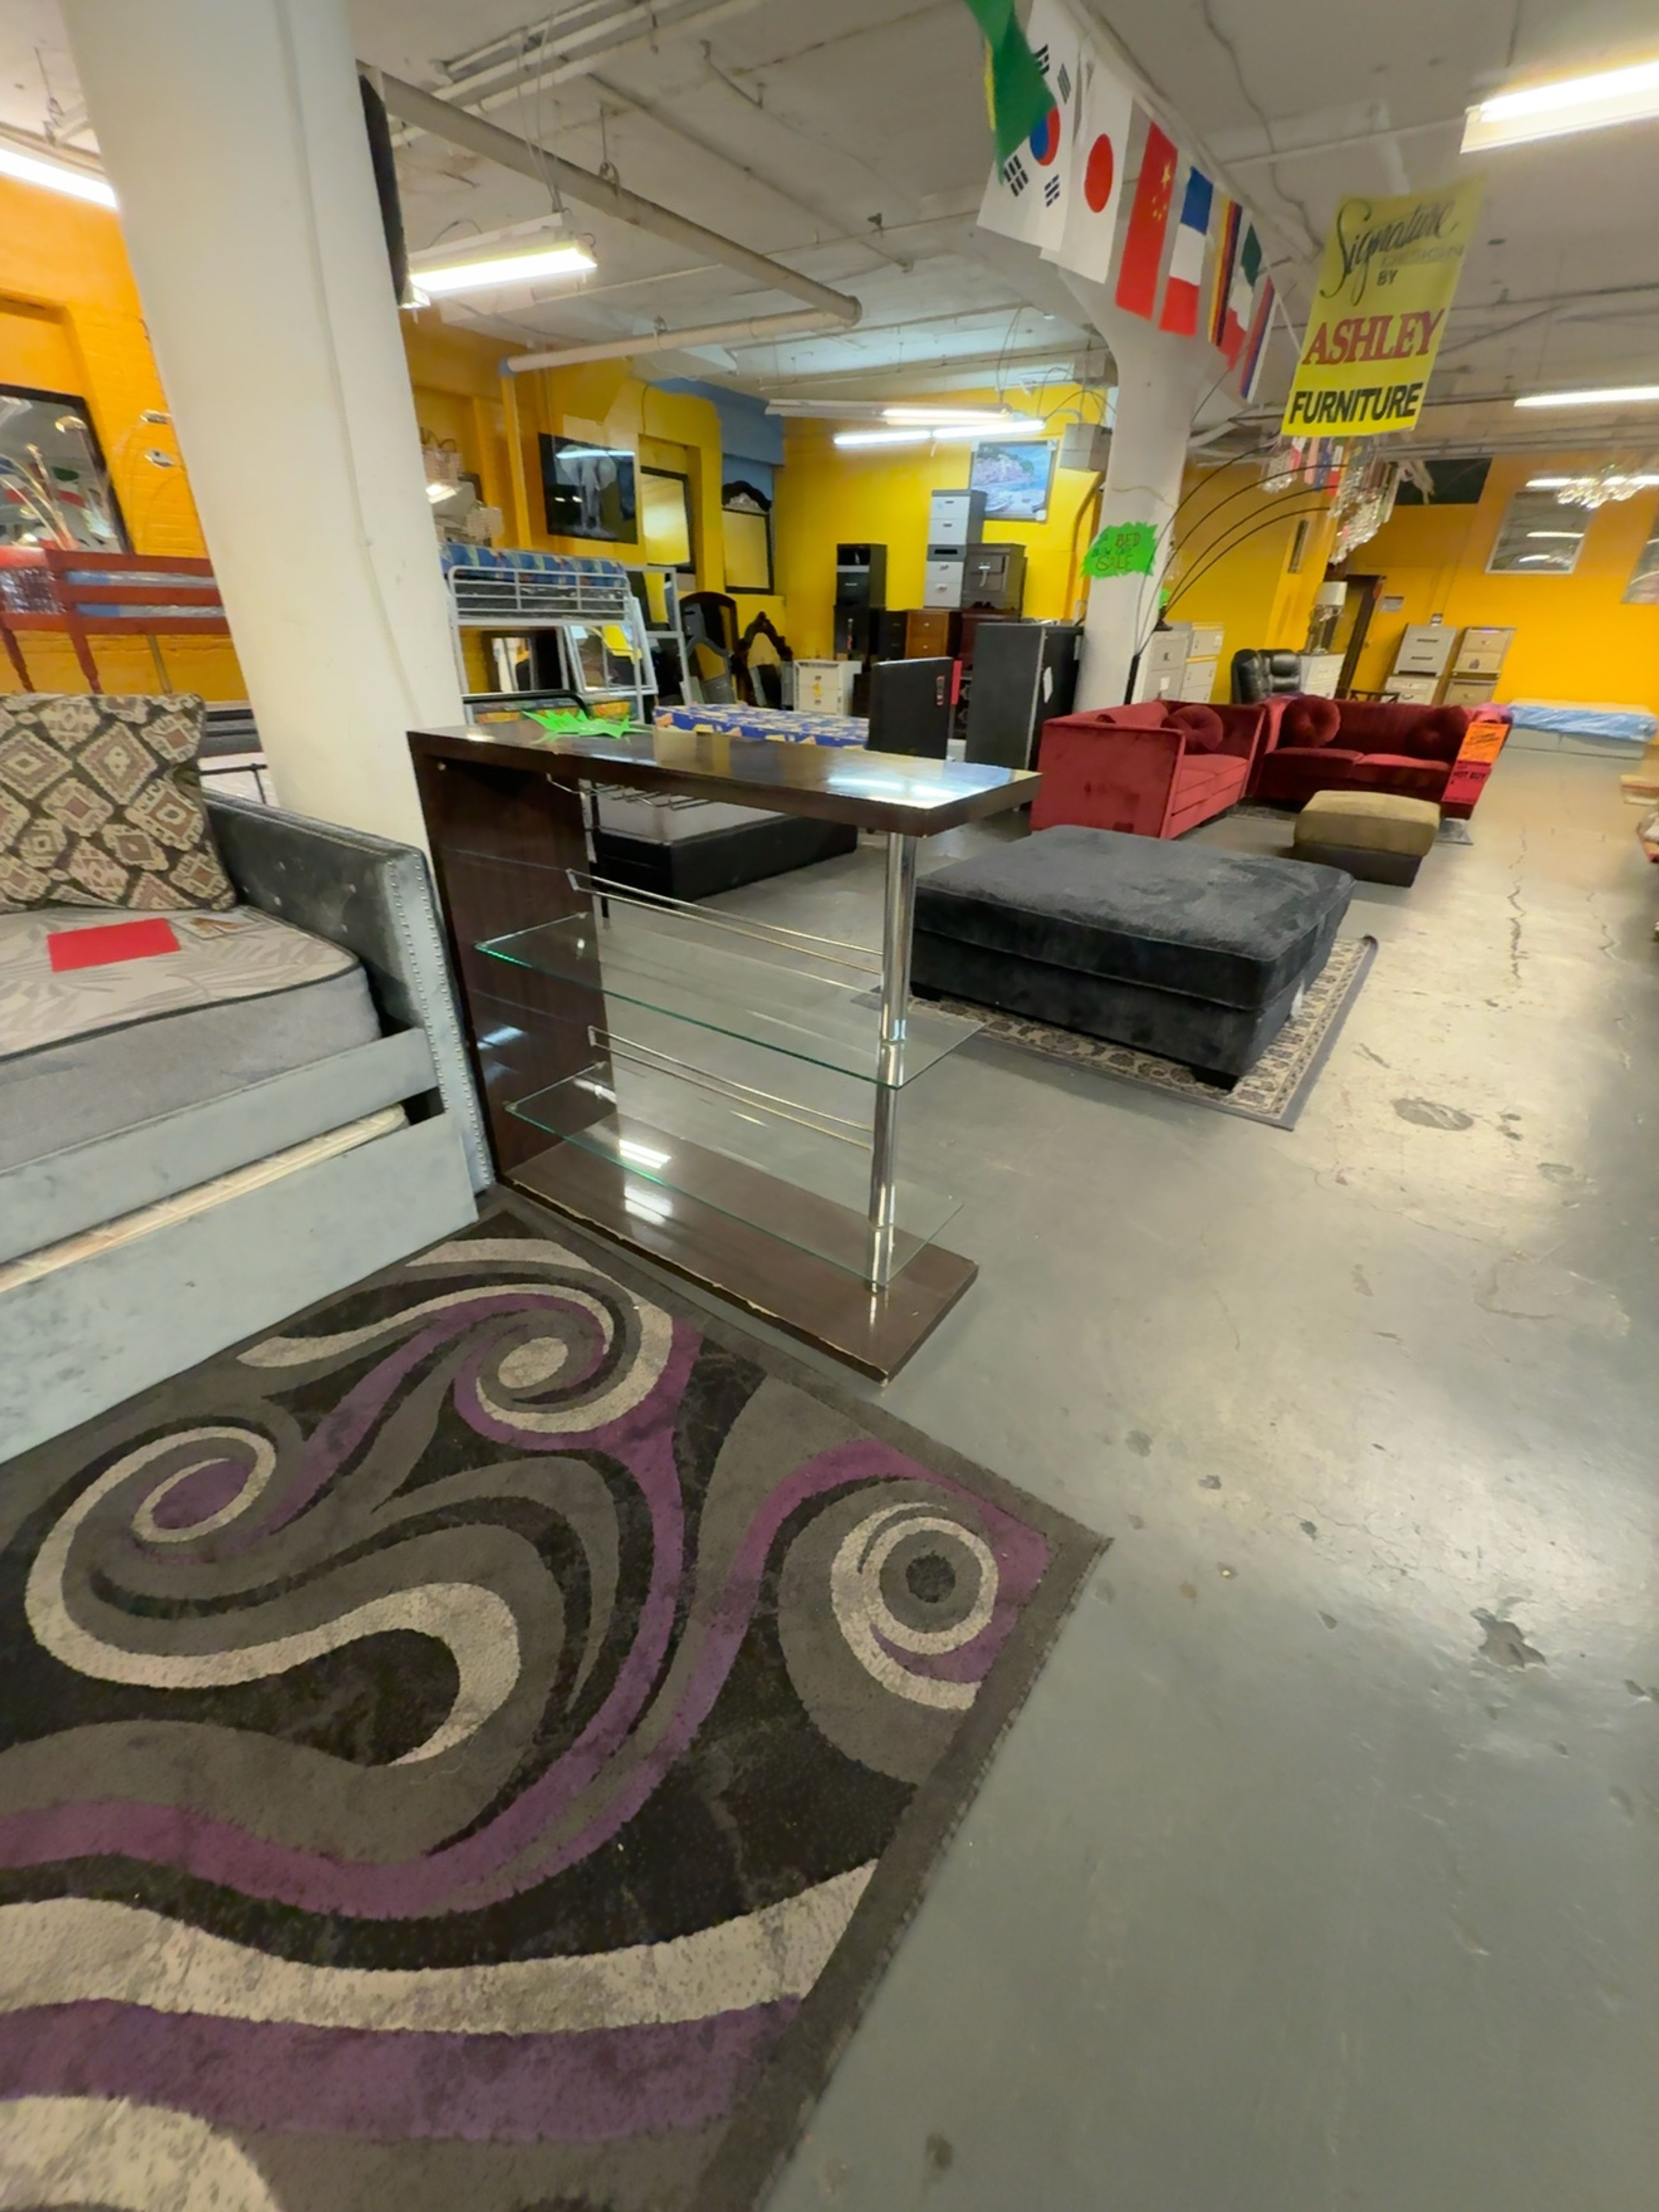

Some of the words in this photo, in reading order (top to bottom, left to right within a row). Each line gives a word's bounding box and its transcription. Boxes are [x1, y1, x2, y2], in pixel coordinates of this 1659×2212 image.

[1377, 269, 1397, 286] BY
[1301, 308, 1445, 365] ASHLEY
[1289, 383, 1424, 424] FURNITURE
